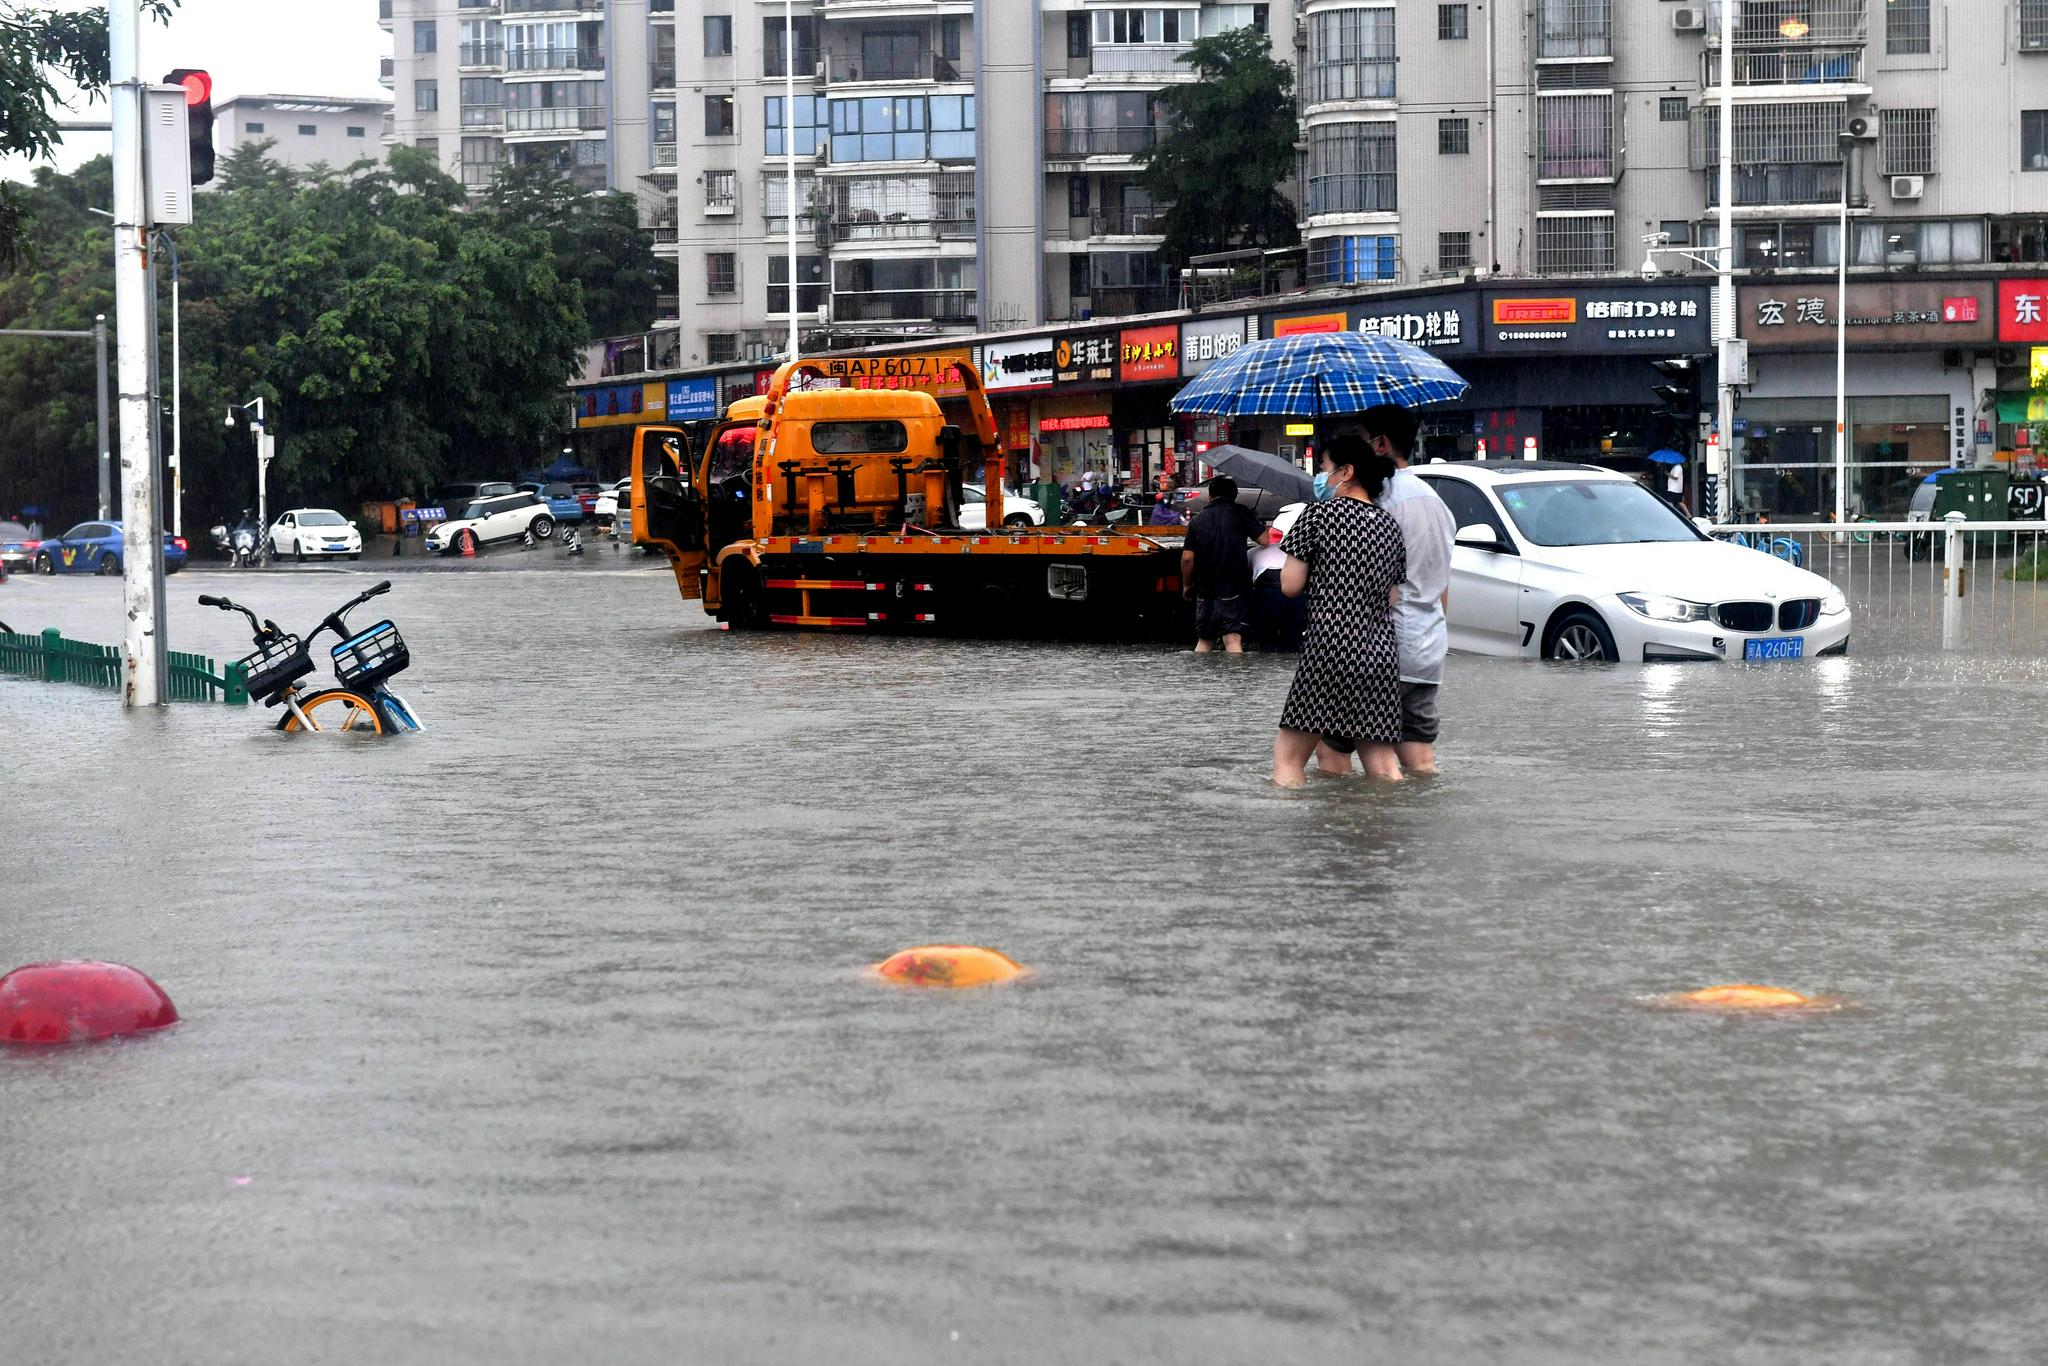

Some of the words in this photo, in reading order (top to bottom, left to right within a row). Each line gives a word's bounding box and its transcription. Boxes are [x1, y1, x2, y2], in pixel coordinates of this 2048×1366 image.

[1499, 302, 1569, 320] PIRELLI
[1585, 301, 1698, 318] 倍耐力轮胎
[1758, 297, 1826, 325] 宏德
[2015, 293, 2048, 324] 东
[1072, 338, 1113, 365] 华莱士
